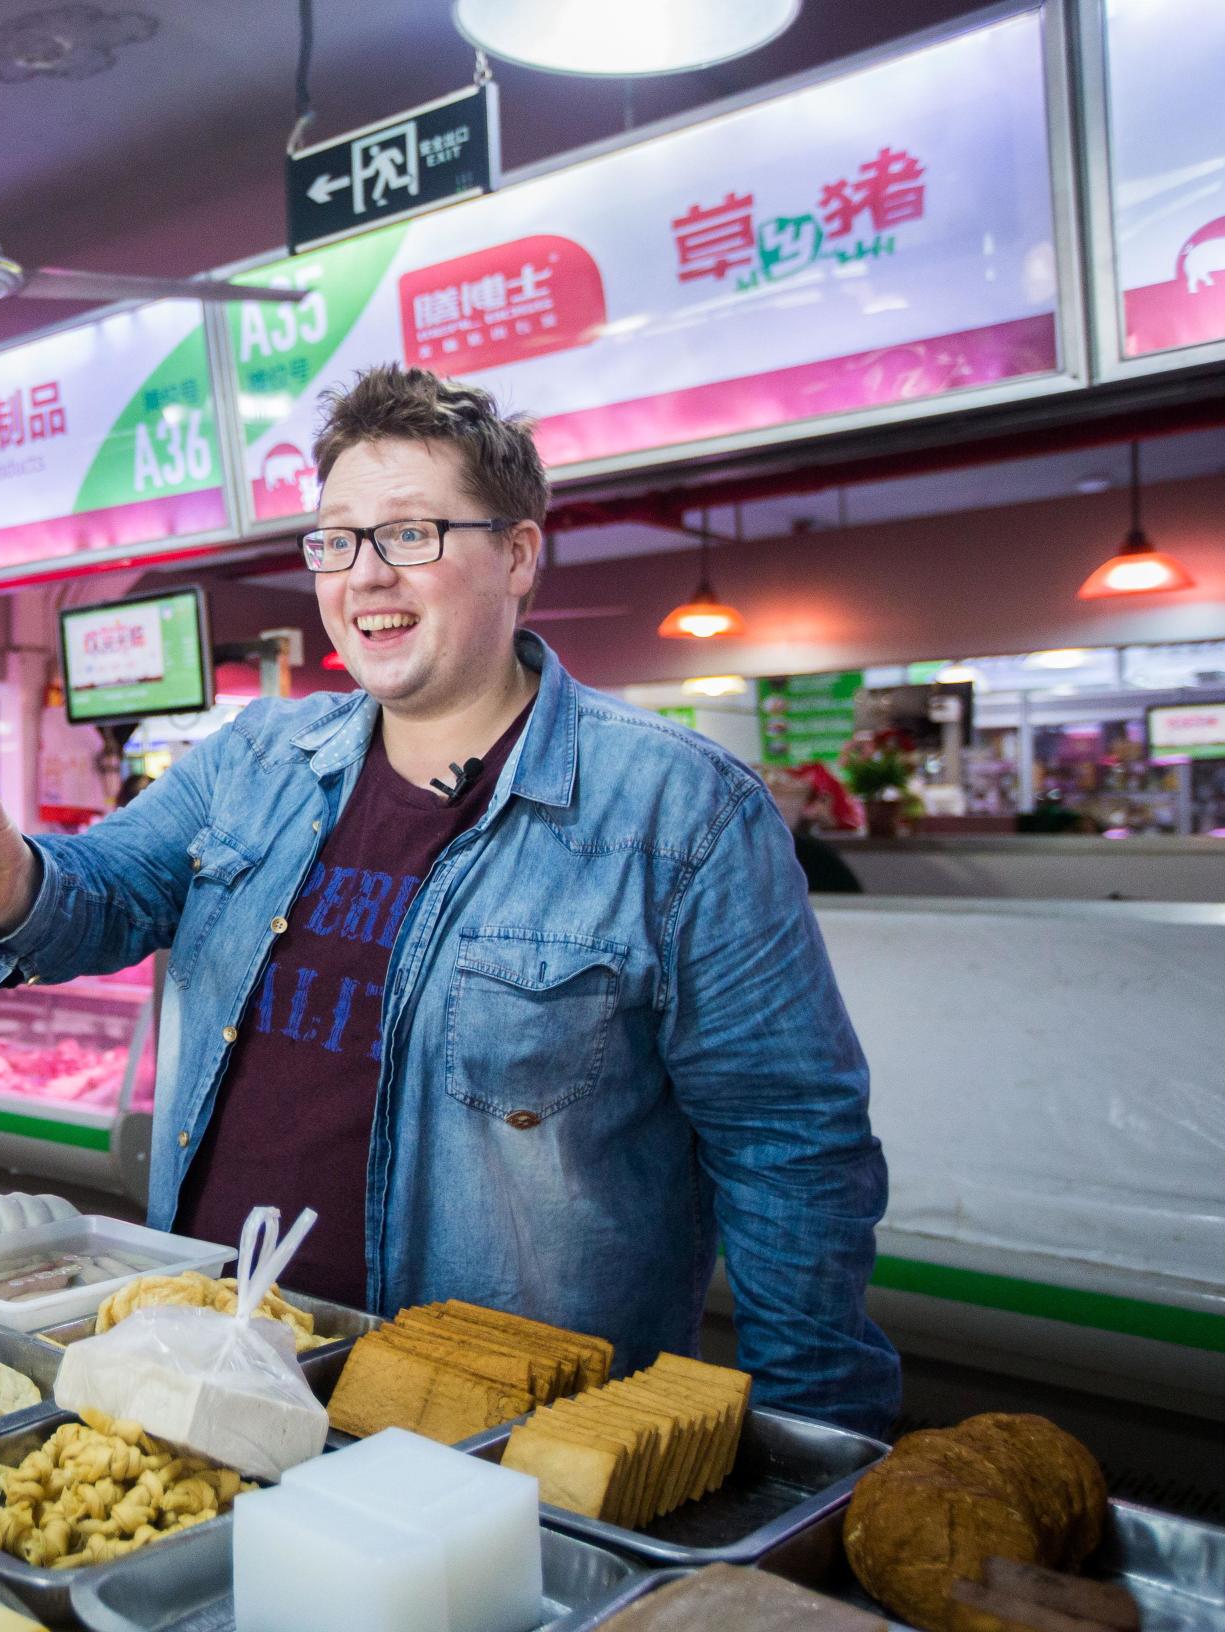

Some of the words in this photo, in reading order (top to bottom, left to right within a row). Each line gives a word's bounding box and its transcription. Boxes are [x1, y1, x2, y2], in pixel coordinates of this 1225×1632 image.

[426, 145, 463, 167] EXIT
[239, 264, 327, 363] A35
[132, 409, 214, 493] A36
